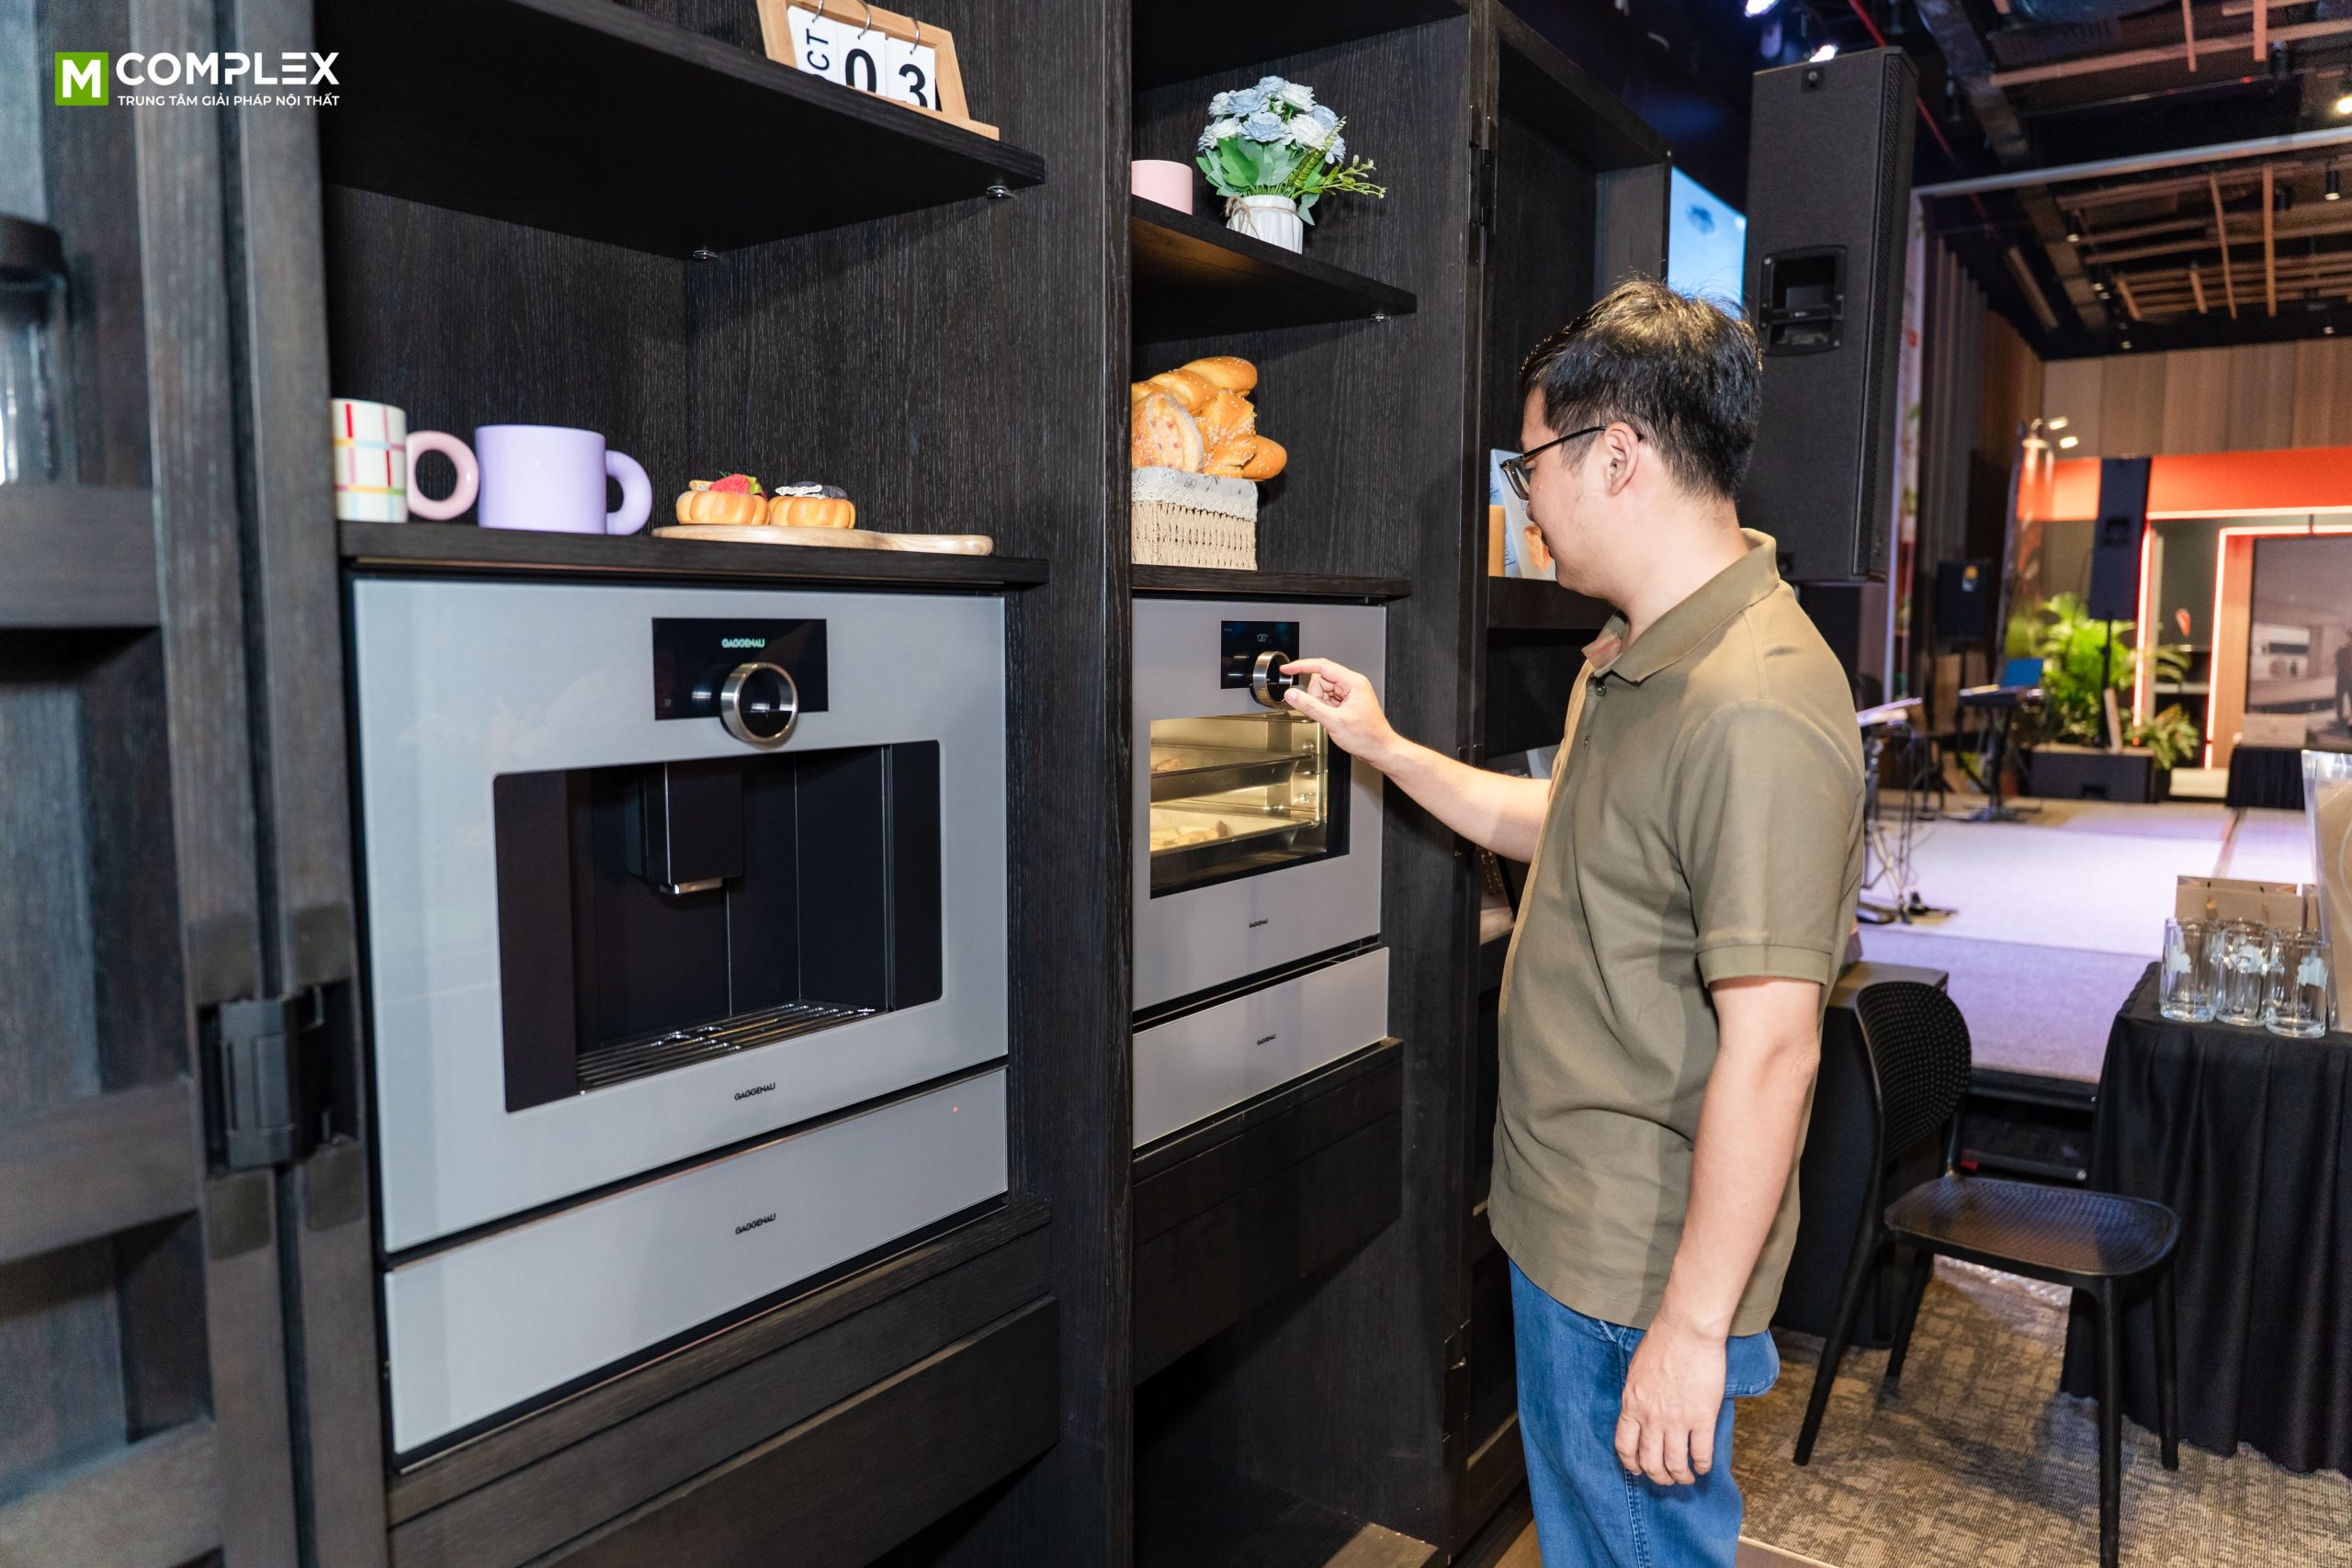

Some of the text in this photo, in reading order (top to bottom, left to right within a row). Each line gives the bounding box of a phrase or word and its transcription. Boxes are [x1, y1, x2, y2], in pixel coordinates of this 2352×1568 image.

[721, 638, 765, 649] GAGGENAU
[734, 1082, 776, 1101] GAGGENAU
[735, 1213, 776, 1235] GAGGENAU
